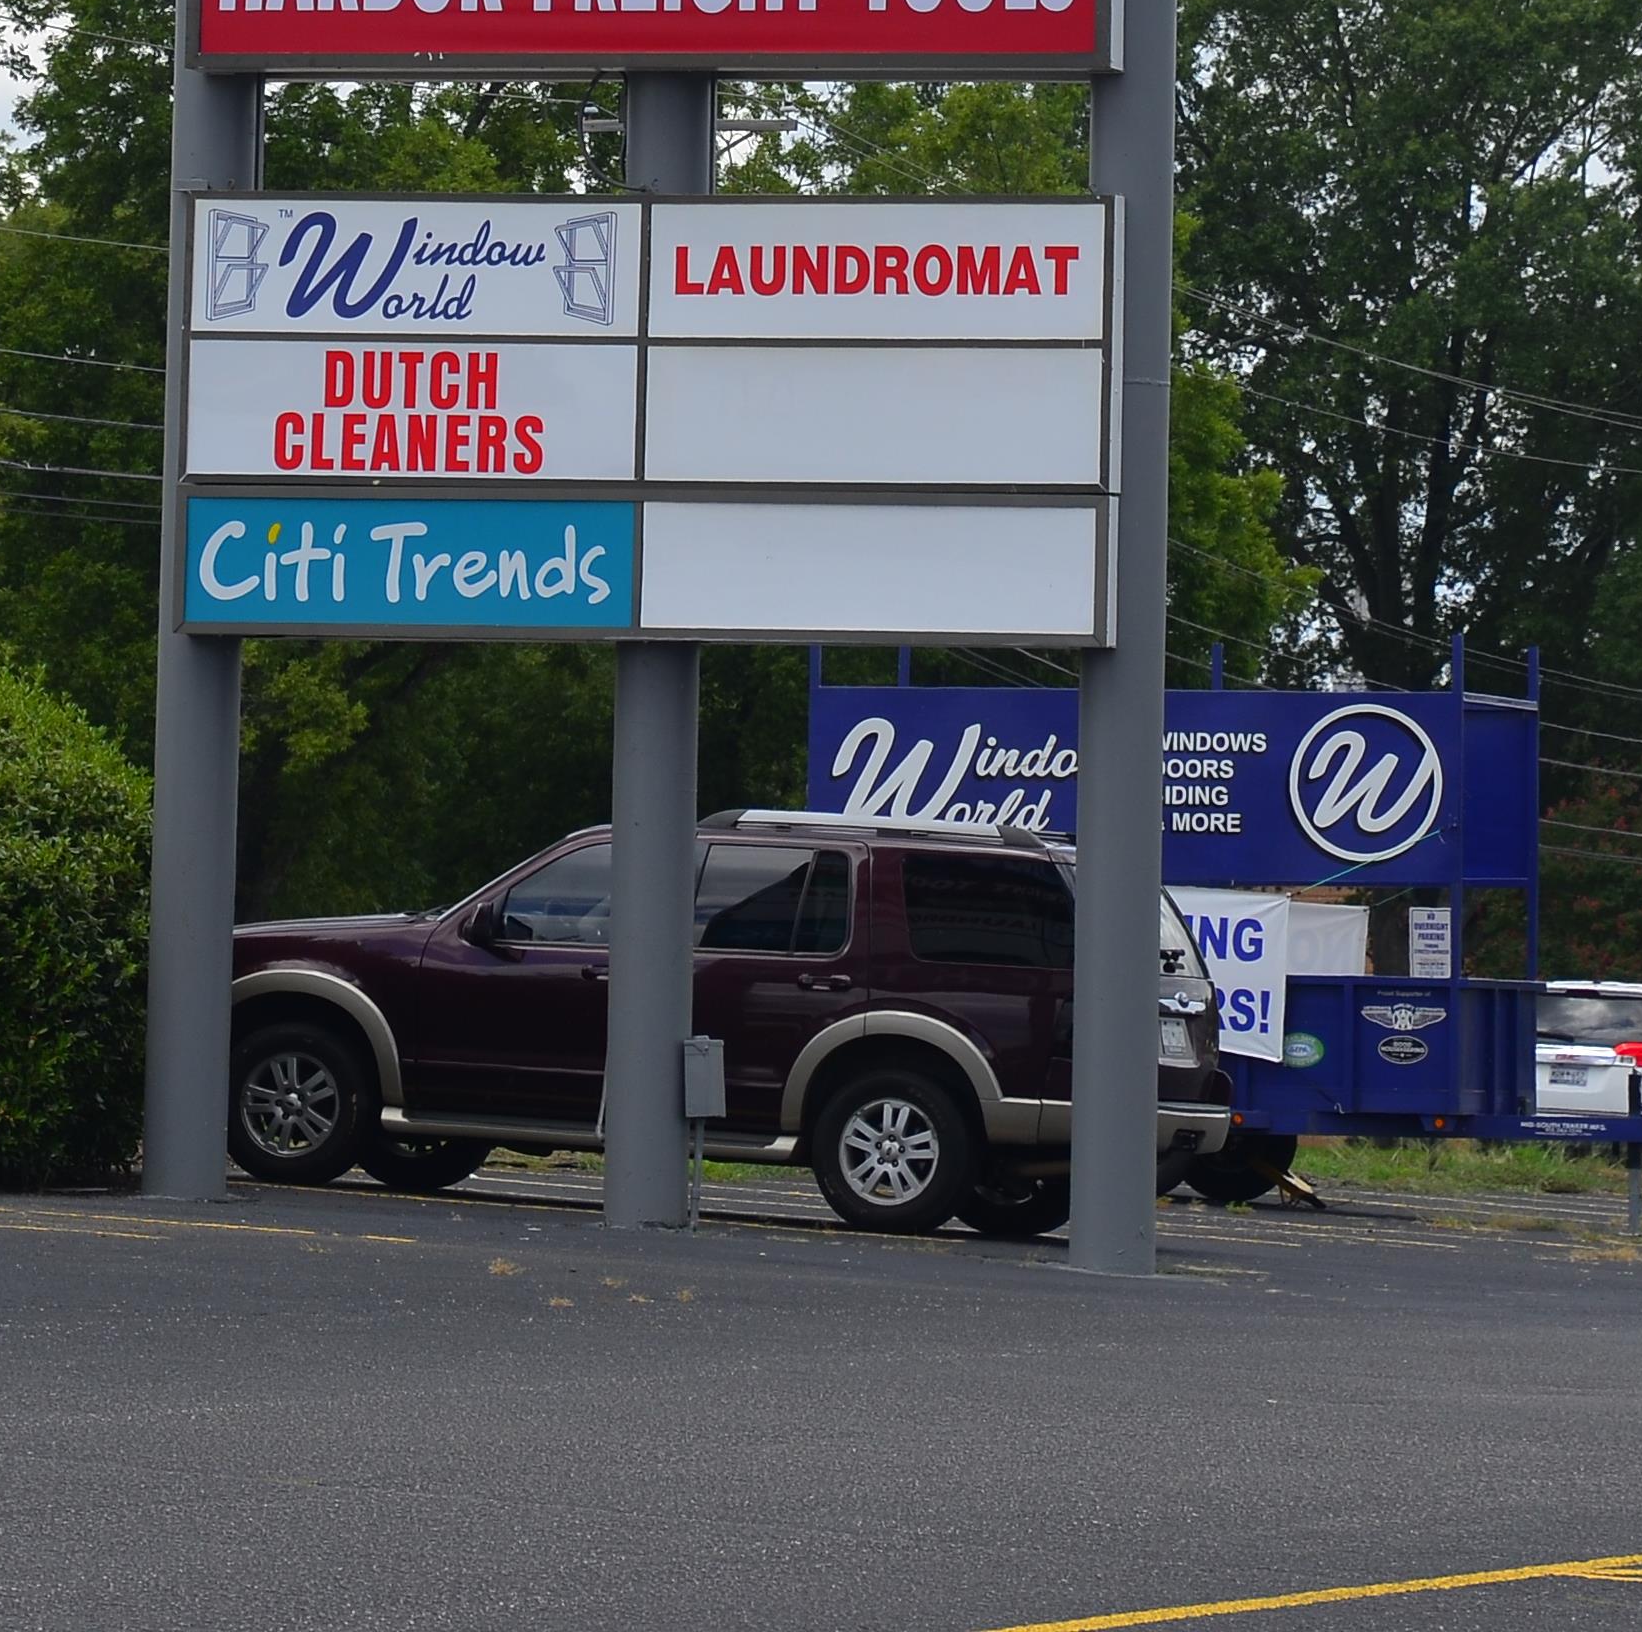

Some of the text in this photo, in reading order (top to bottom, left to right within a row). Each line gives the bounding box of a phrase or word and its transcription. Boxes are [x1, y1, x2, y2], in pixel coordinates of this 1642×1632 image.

[278, 211, 546, 319] Window
[674, 243, 1081, 298] LAUNDROMAT
[323, 349, 500, 410] DUTCH
[273, 412, 545, 475] CLEANERS
[198, 519, 613, 607] Citi Trends
[831, 717, 1079, 820] Windo
[1162, 758, 1235, 779] OORS
[1162, 785, 1229, 806] IDING
[1172, 812, 1242, 833] MORE
[1183, 914, 1264, 963] NG
